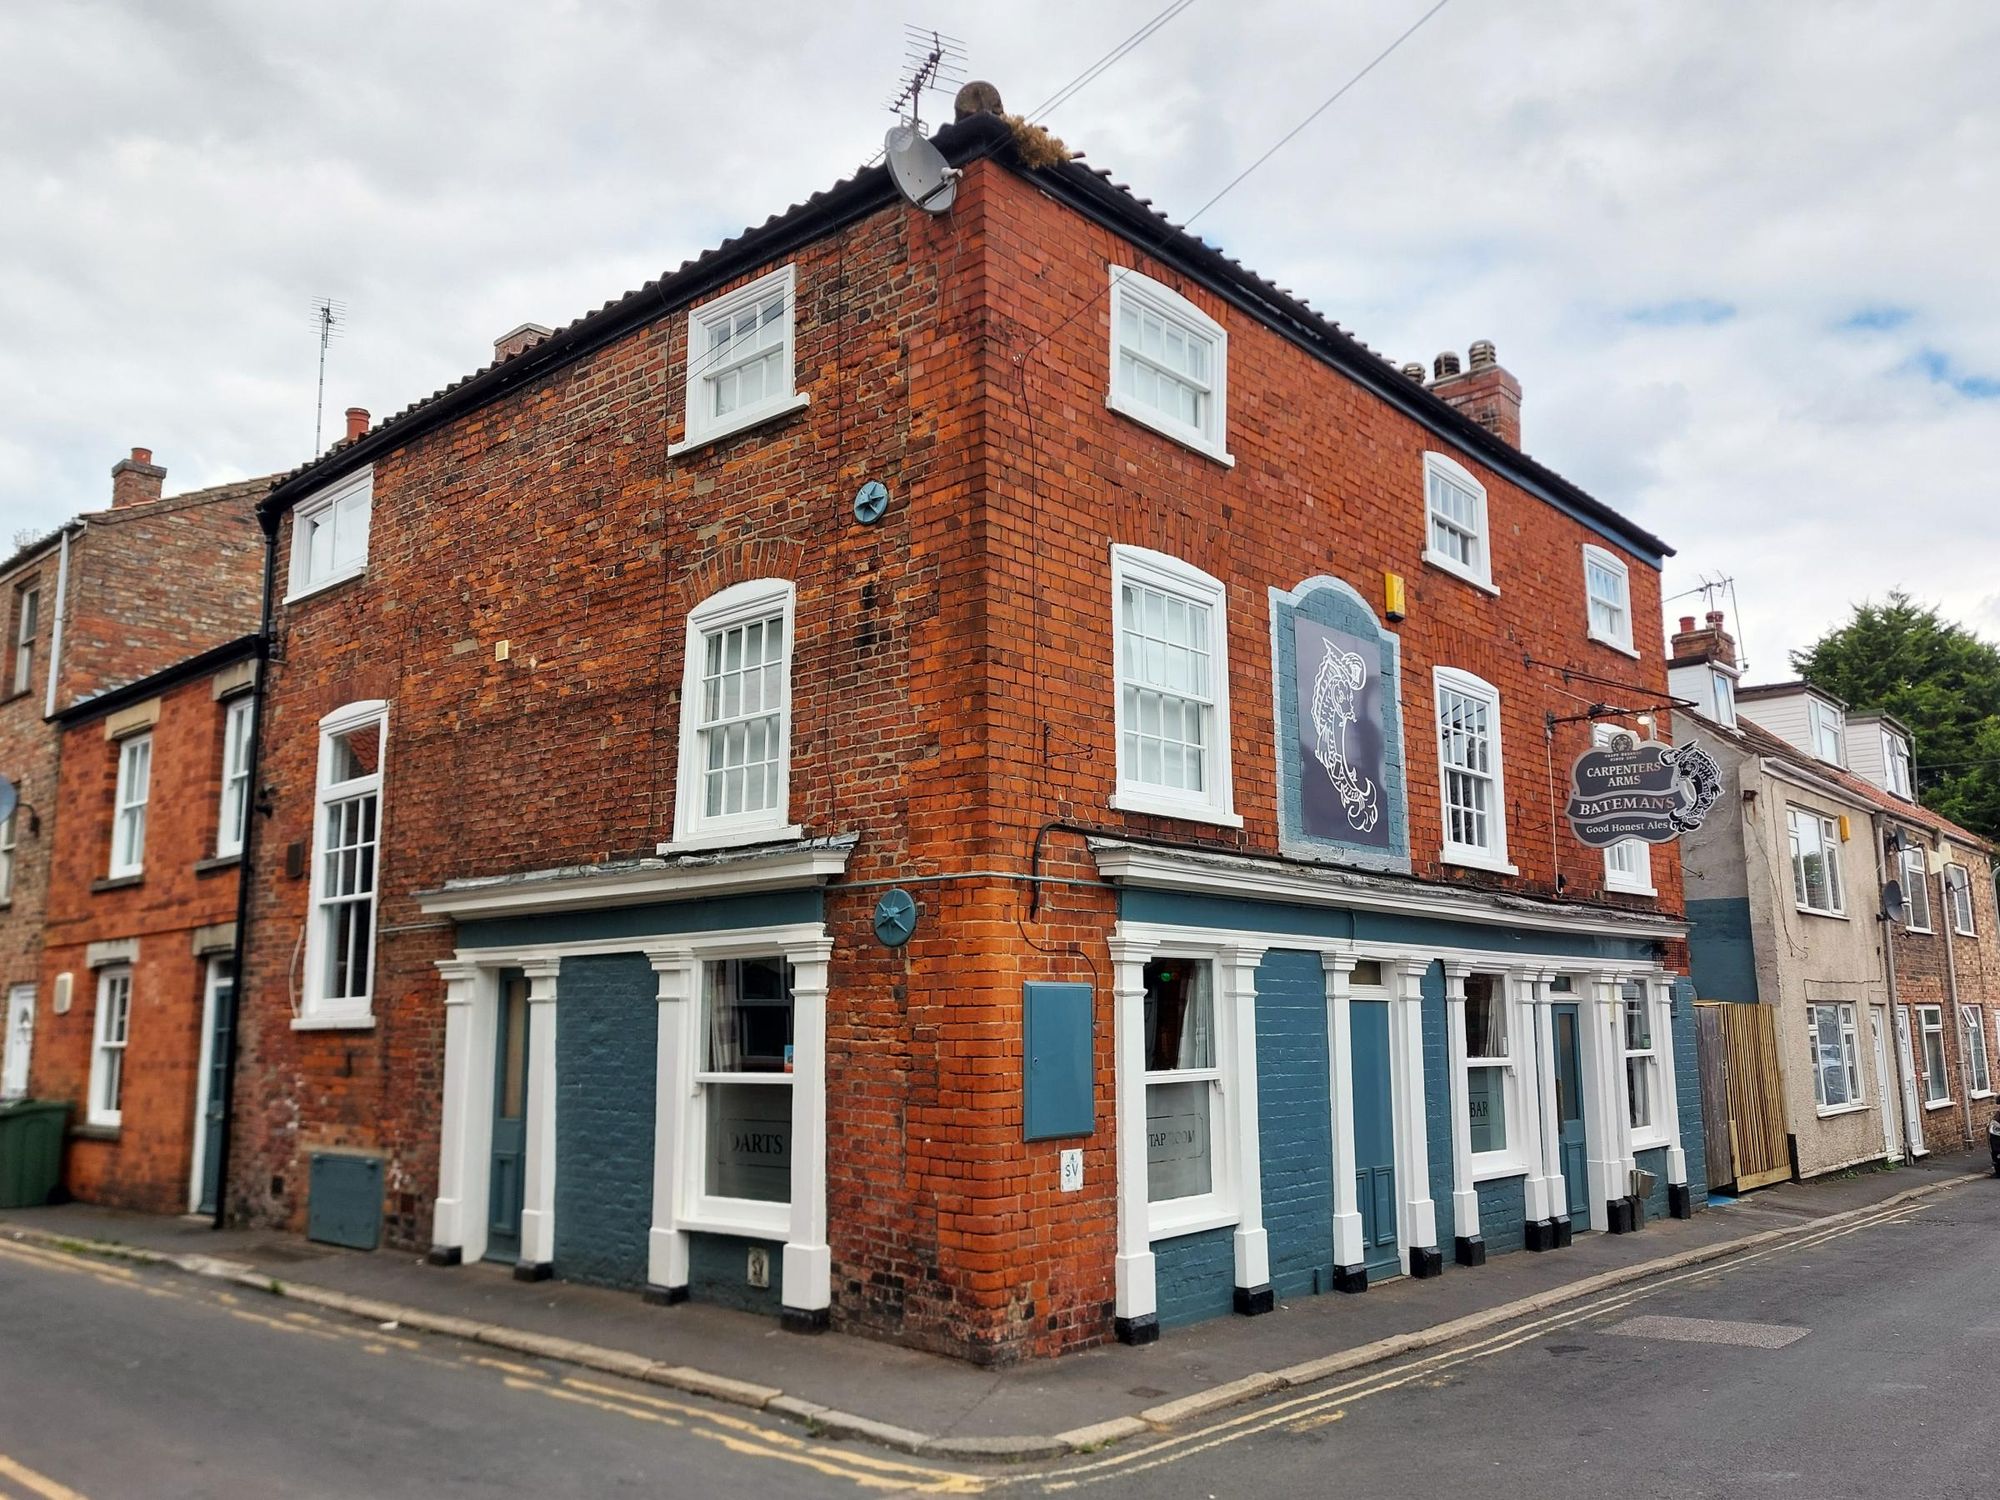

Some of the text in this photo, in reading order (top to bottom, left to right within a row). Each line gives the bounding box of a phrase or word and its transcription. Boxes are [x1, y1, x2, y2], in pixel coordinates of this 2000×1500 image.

[1586, 761, 1661, 778] CARPENTERS
[1607, 775, 1641, 787] ARMS
[1578, 796, 1676, 815] BATEMANS
[1586, 820, 1668, 834] Good Honest Ales
[1470, 1101, 1488, 1118] BAR
[1148, 1132, 1167, 1147] TAP
[1065, 1162, 1079, 1178] SV
